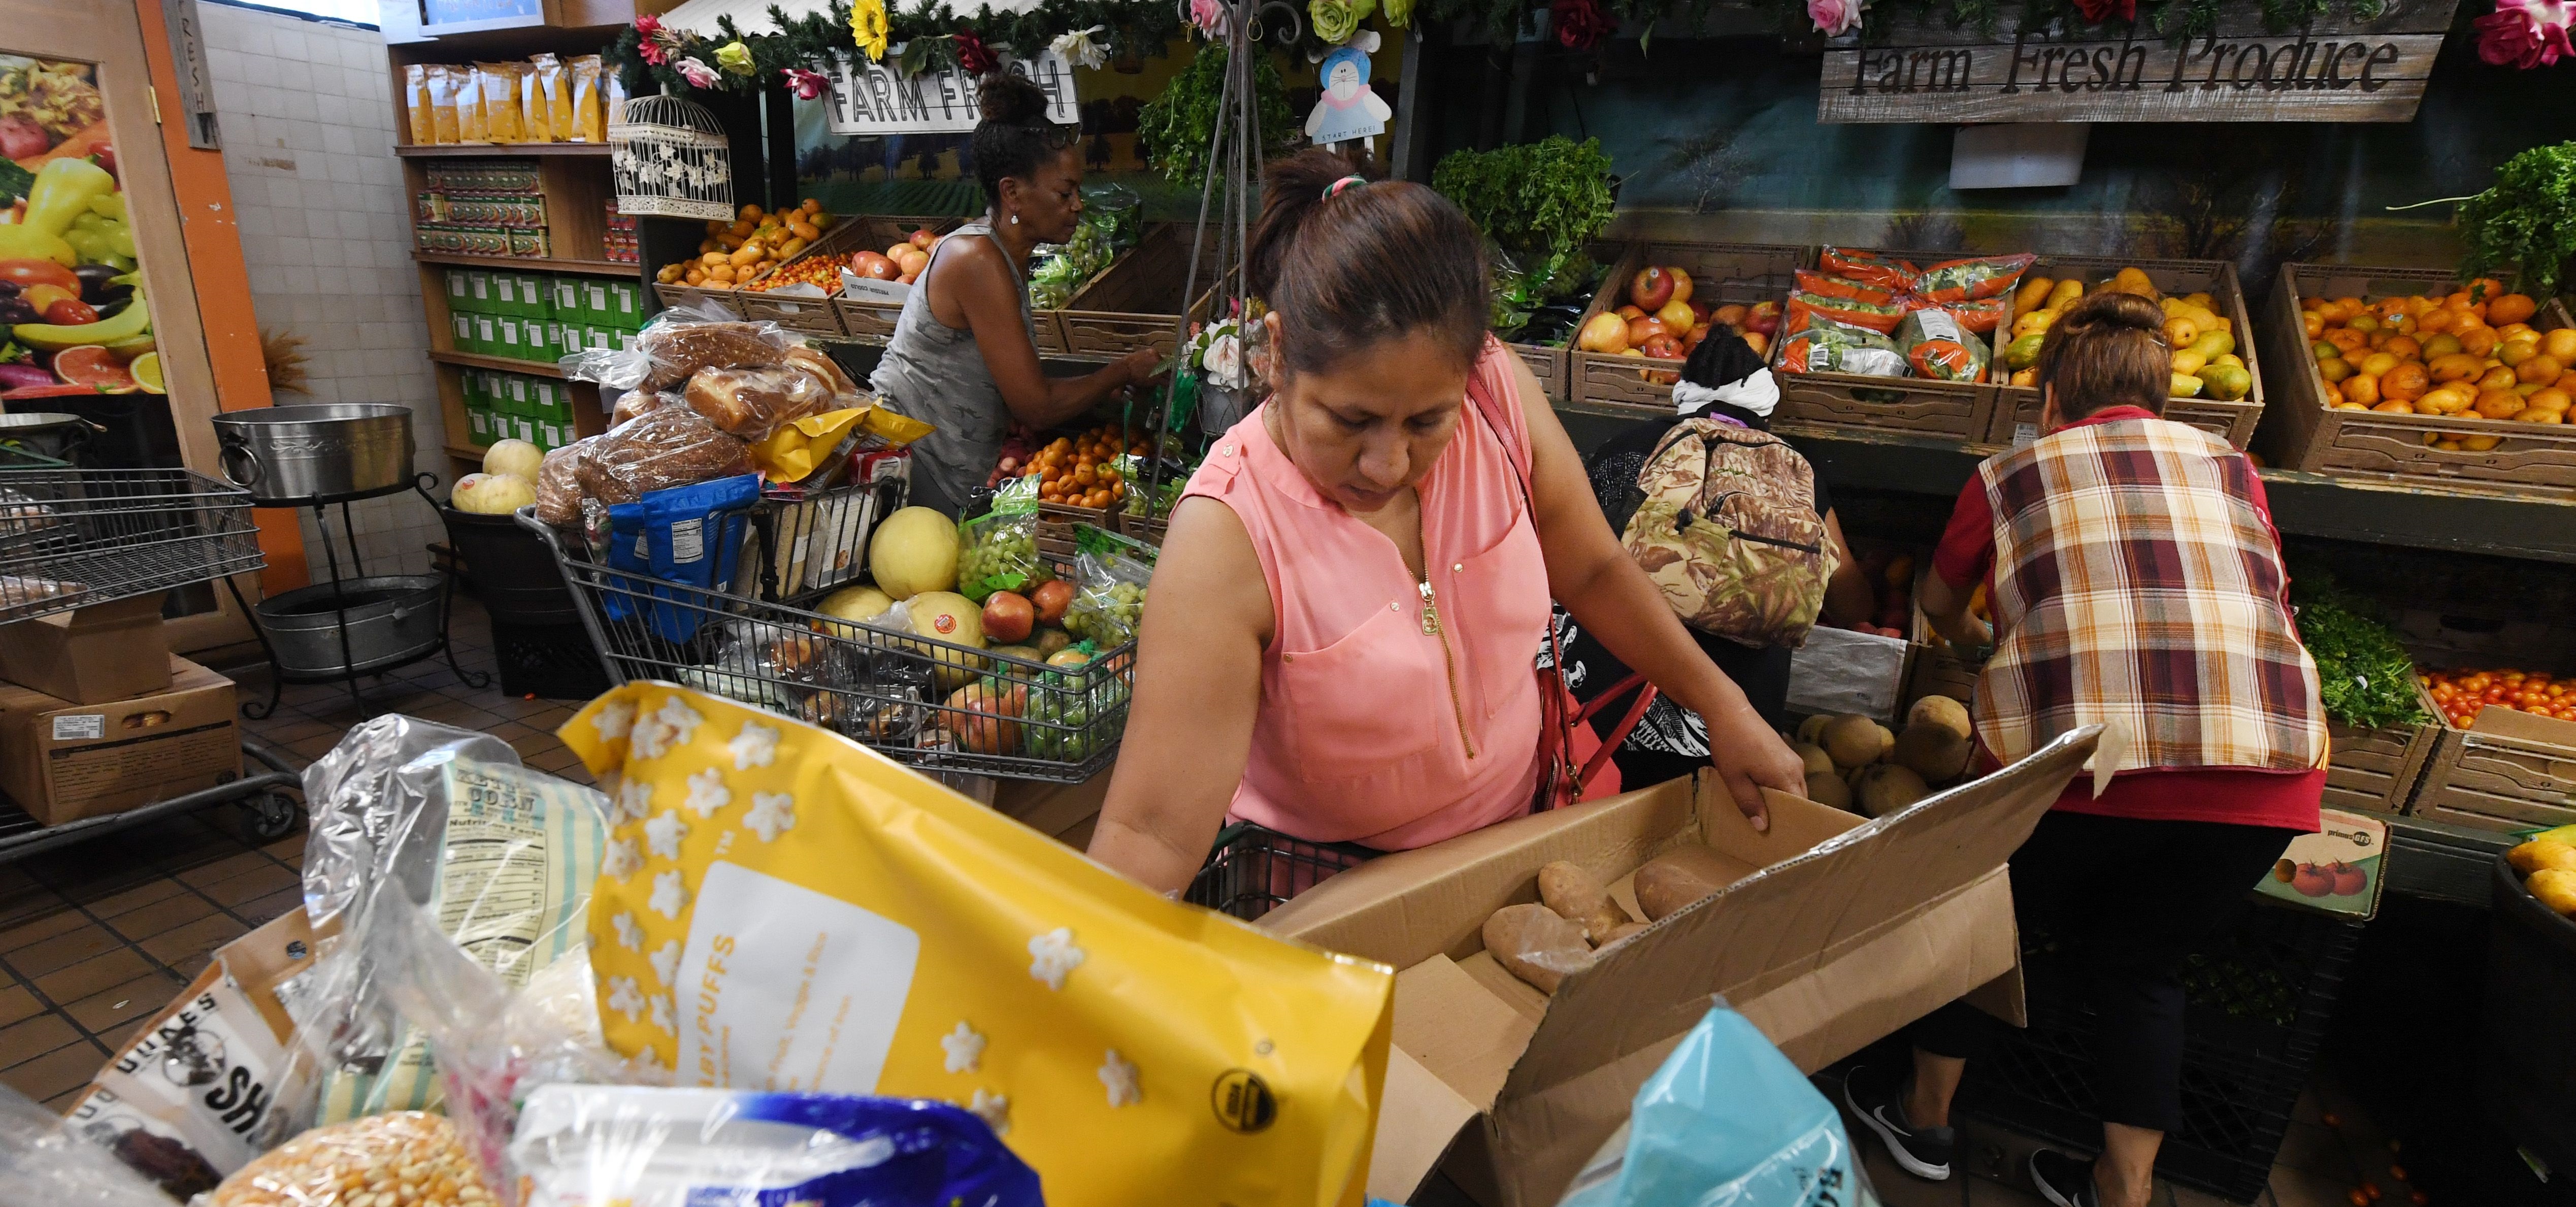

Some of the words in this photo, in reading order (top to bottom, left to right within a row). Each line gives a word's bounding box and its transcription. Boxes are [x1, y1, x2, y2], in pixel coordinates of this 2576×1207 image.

[828, 67, 930, 123] FARM
[937, 59, 1066, 120] FRH
[1848, 43, 1973, 95] Farm
[2000, 23, 2145, 93] Fresh
[2164, 20, 2398, 92] Produce
[1322, 132, 1347, 141] START
[1352, 125, 1375, 135] HERE!
[697, 933, 736, 1036] PUFFS
